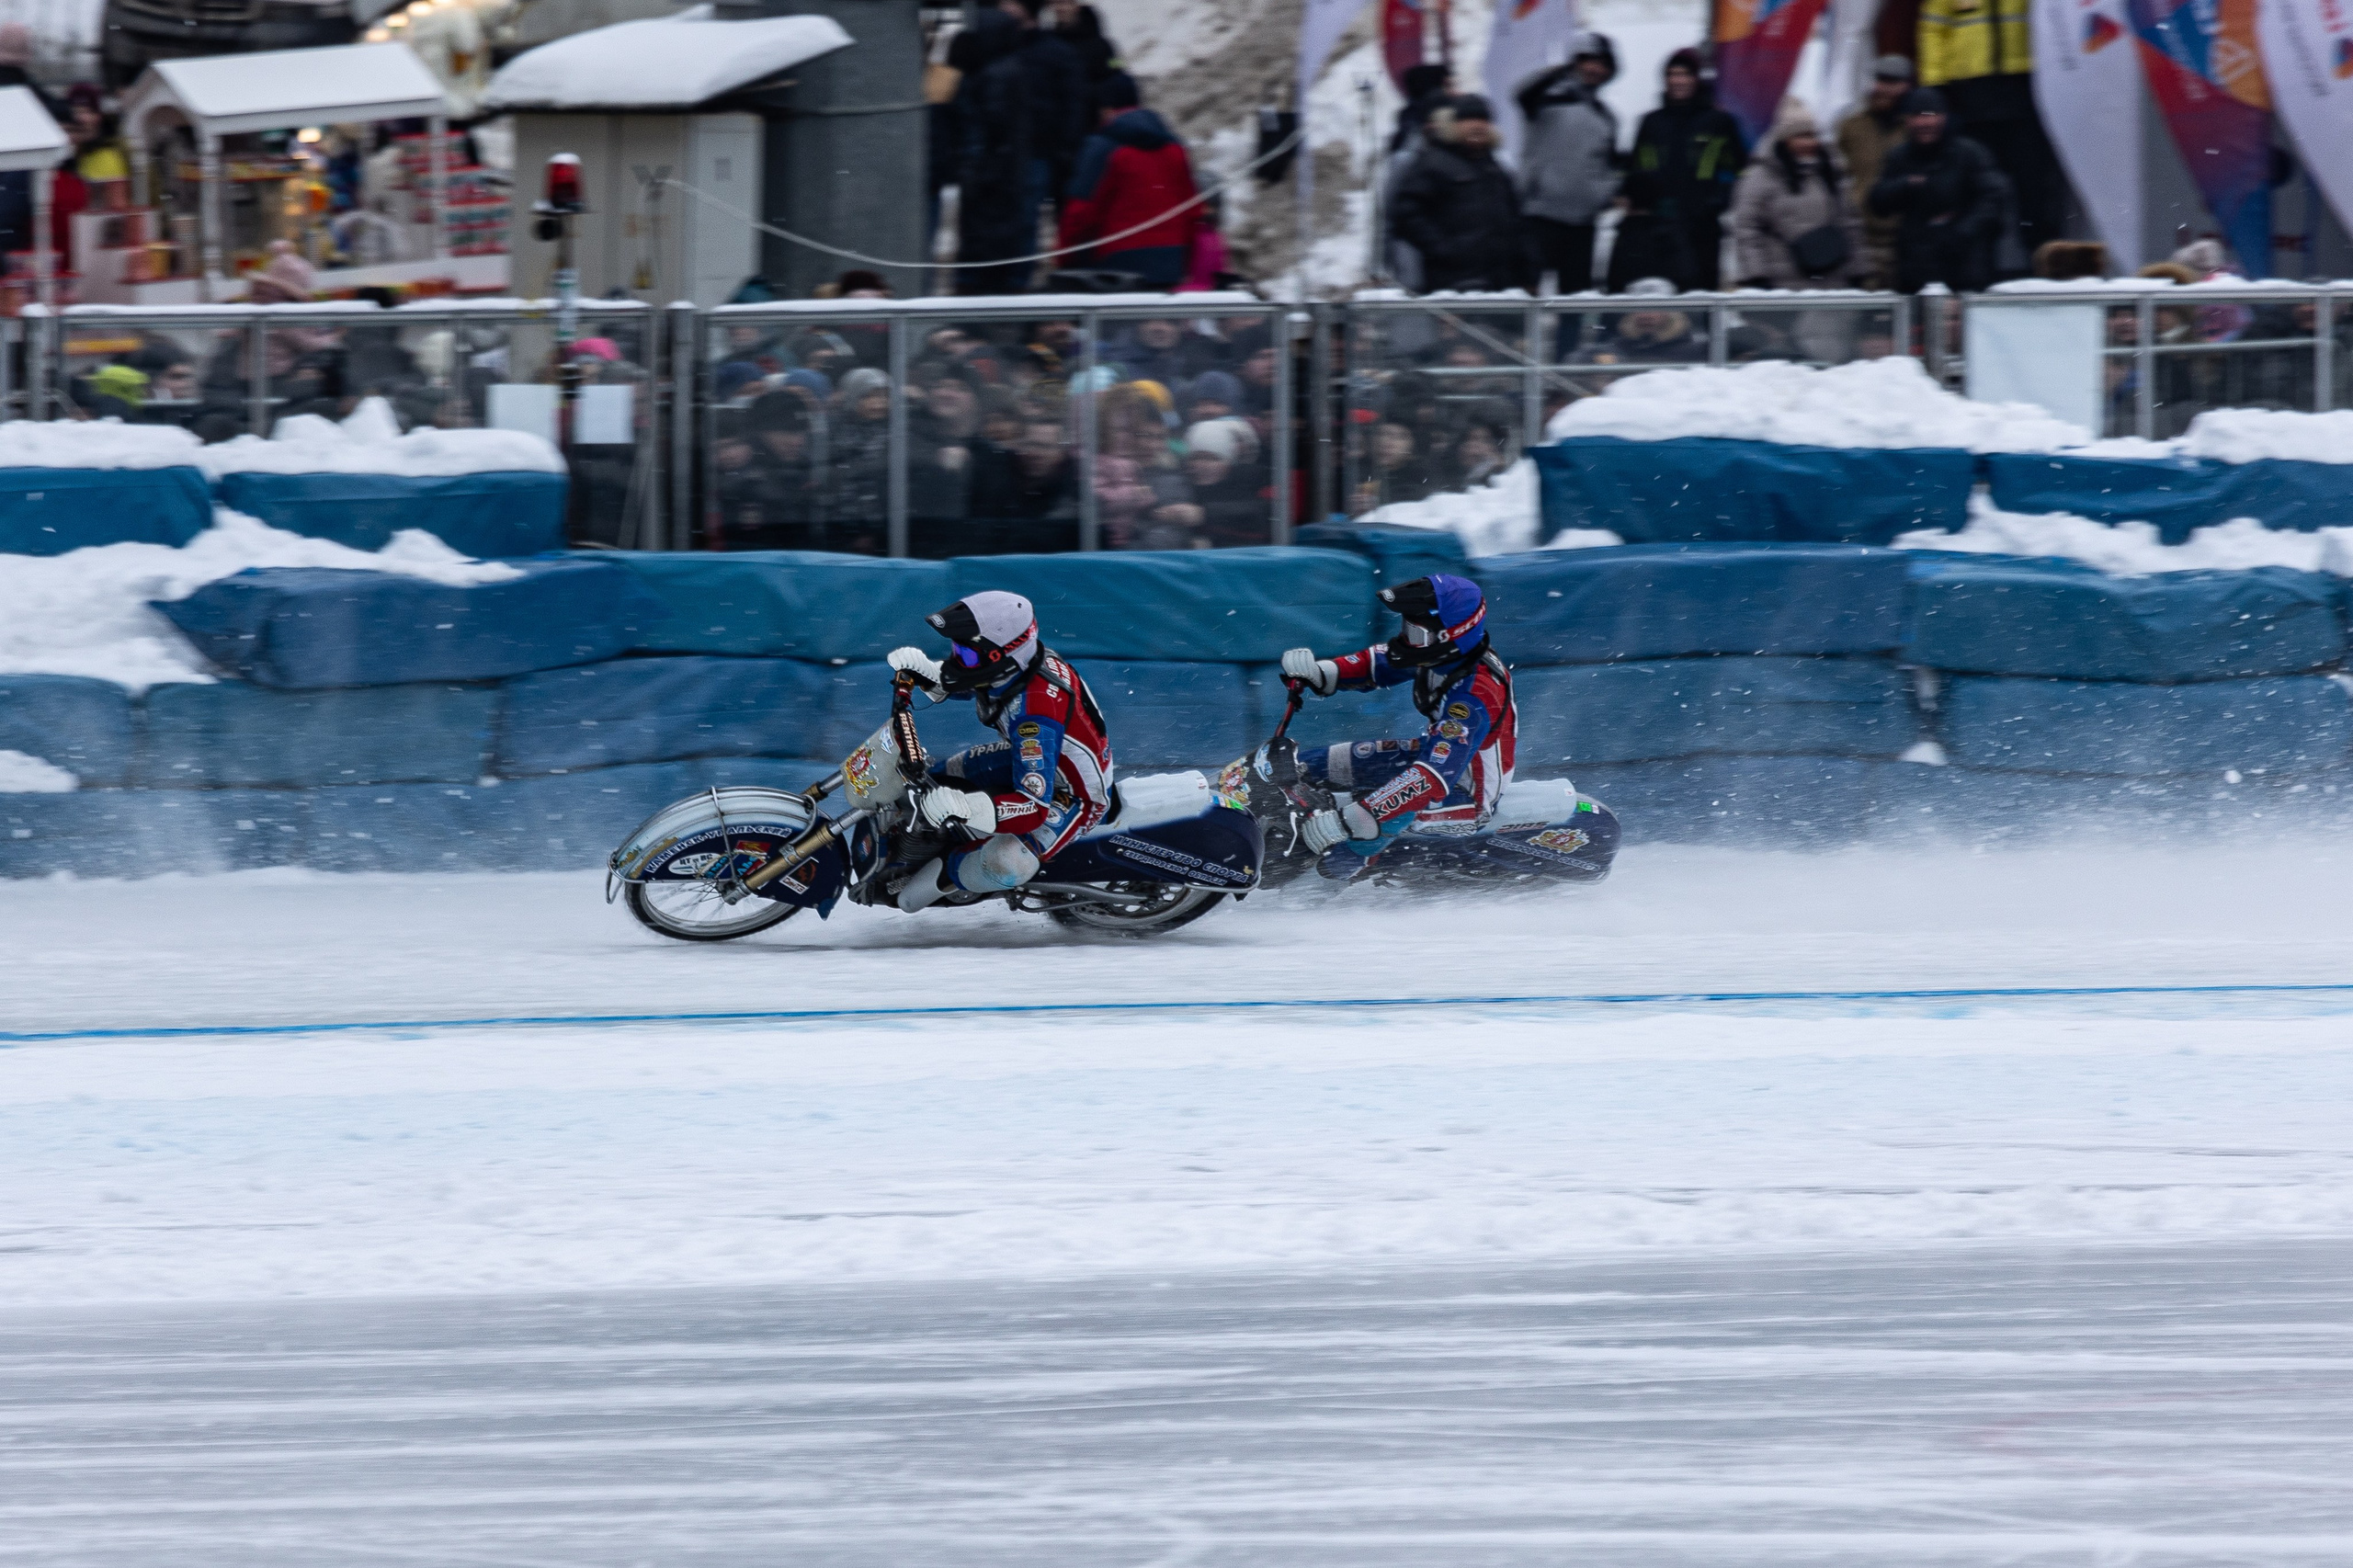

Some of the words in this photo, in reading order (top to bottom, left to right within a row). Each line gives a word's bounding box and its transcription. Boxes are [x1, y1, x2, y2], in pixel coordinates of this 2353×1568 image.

[899, 712, 919, 763] RENTHAL
[1370, 776, 1432, 820] KUMZ
[1108, 835, 1202, 867] МИНИСТЕРСТВО
[1202, 862, 1250, 883] СПОРТА
[1122, 849, 1189, 875] СВЕРДЛОВСКОЙ
